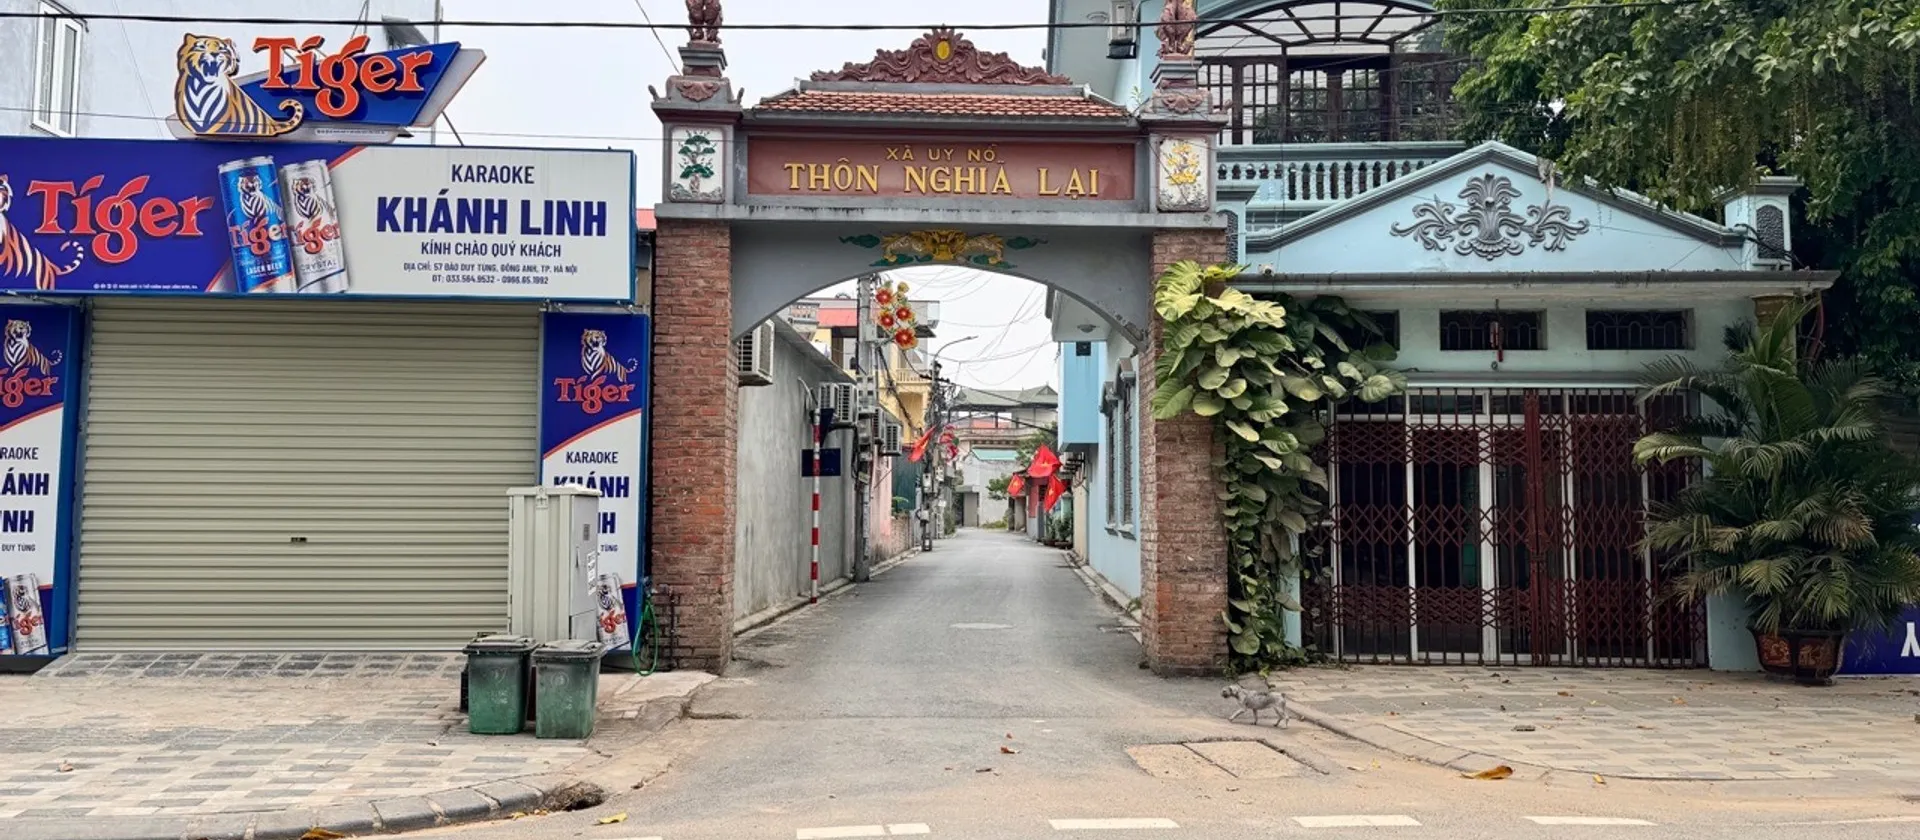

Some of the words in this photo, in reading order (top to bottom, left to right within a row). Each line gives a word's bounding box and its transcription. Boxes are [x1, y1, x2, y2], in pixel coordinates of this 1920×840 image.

[253, 33, 433, 117] Tiger
[928, 148, 954, 161] UY
[451, 164, 535, 184] KARAOKE
[784, 157, 880, 193] THÔN
[1038, 167, 1098, 199] LẠI
[26, 174, 215, 264] Tiger
[376, 188, 508, 234] KHÁNH
[520, 199, 607, 236] LINH
[229, 217, 287, 255] Tiger
[421, 239, 451, 256] KÍNH
[454, 240, 488, 257] CHÀO
[491, 240, 517, 258] QUÝ
[520, 242, 562, 258] KHÁCH
[433, 262, 443, 271] 57
[460, 263, 475, 272] DUY
[0, 367, 59, 408] iger
[554, 375, 635, 414] Tiger
[0, 446, 39, 460] RAOKE
[566, 451, 619, 464] KARAOKE
[0, 467, 50, 496] ÁNH
